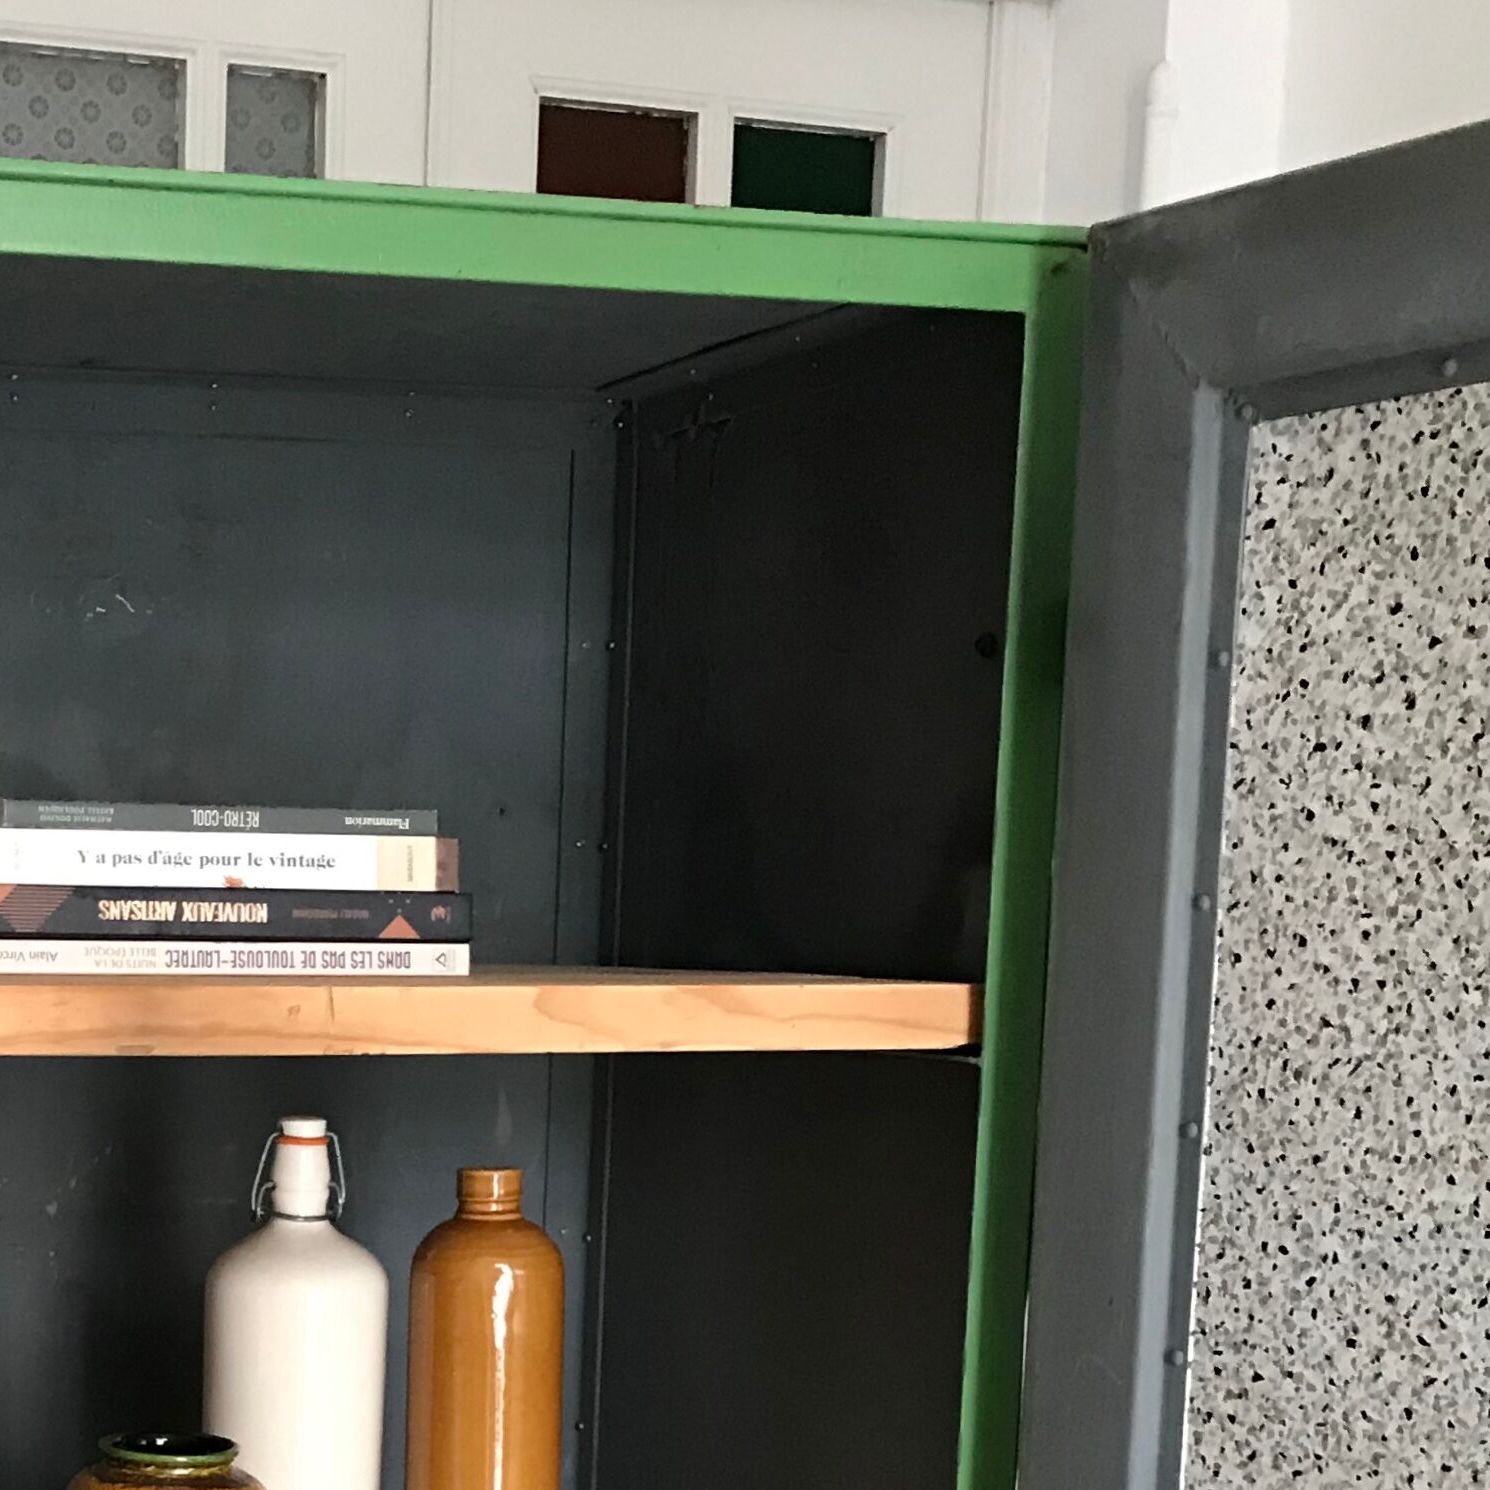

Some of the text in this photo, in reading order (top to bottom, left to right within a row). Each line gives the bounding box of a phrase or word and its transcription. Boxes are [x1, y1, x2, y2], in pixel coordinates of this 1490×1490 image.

[191, 809, 260, 830] RÉTRO-COOL
[345, 816, 410, 830] Flammarion
[77, 849, 89, 864] Y
[95, 851, 106, 864] a
[112, 851, 142, 867] pas
[199, 853, 241, 869] pour
[248, 852, 263, 867] le
[269, 852, 337, 870] vintage
[98, 899, 177, 921] ARTISANS
[181, 901, 268, 923] NOUVEAUX
[29, 950, 59, 962] Alain
[165, 949, 411, 969] DANS LES PAS DE TOULOUSE-LAUTREC
